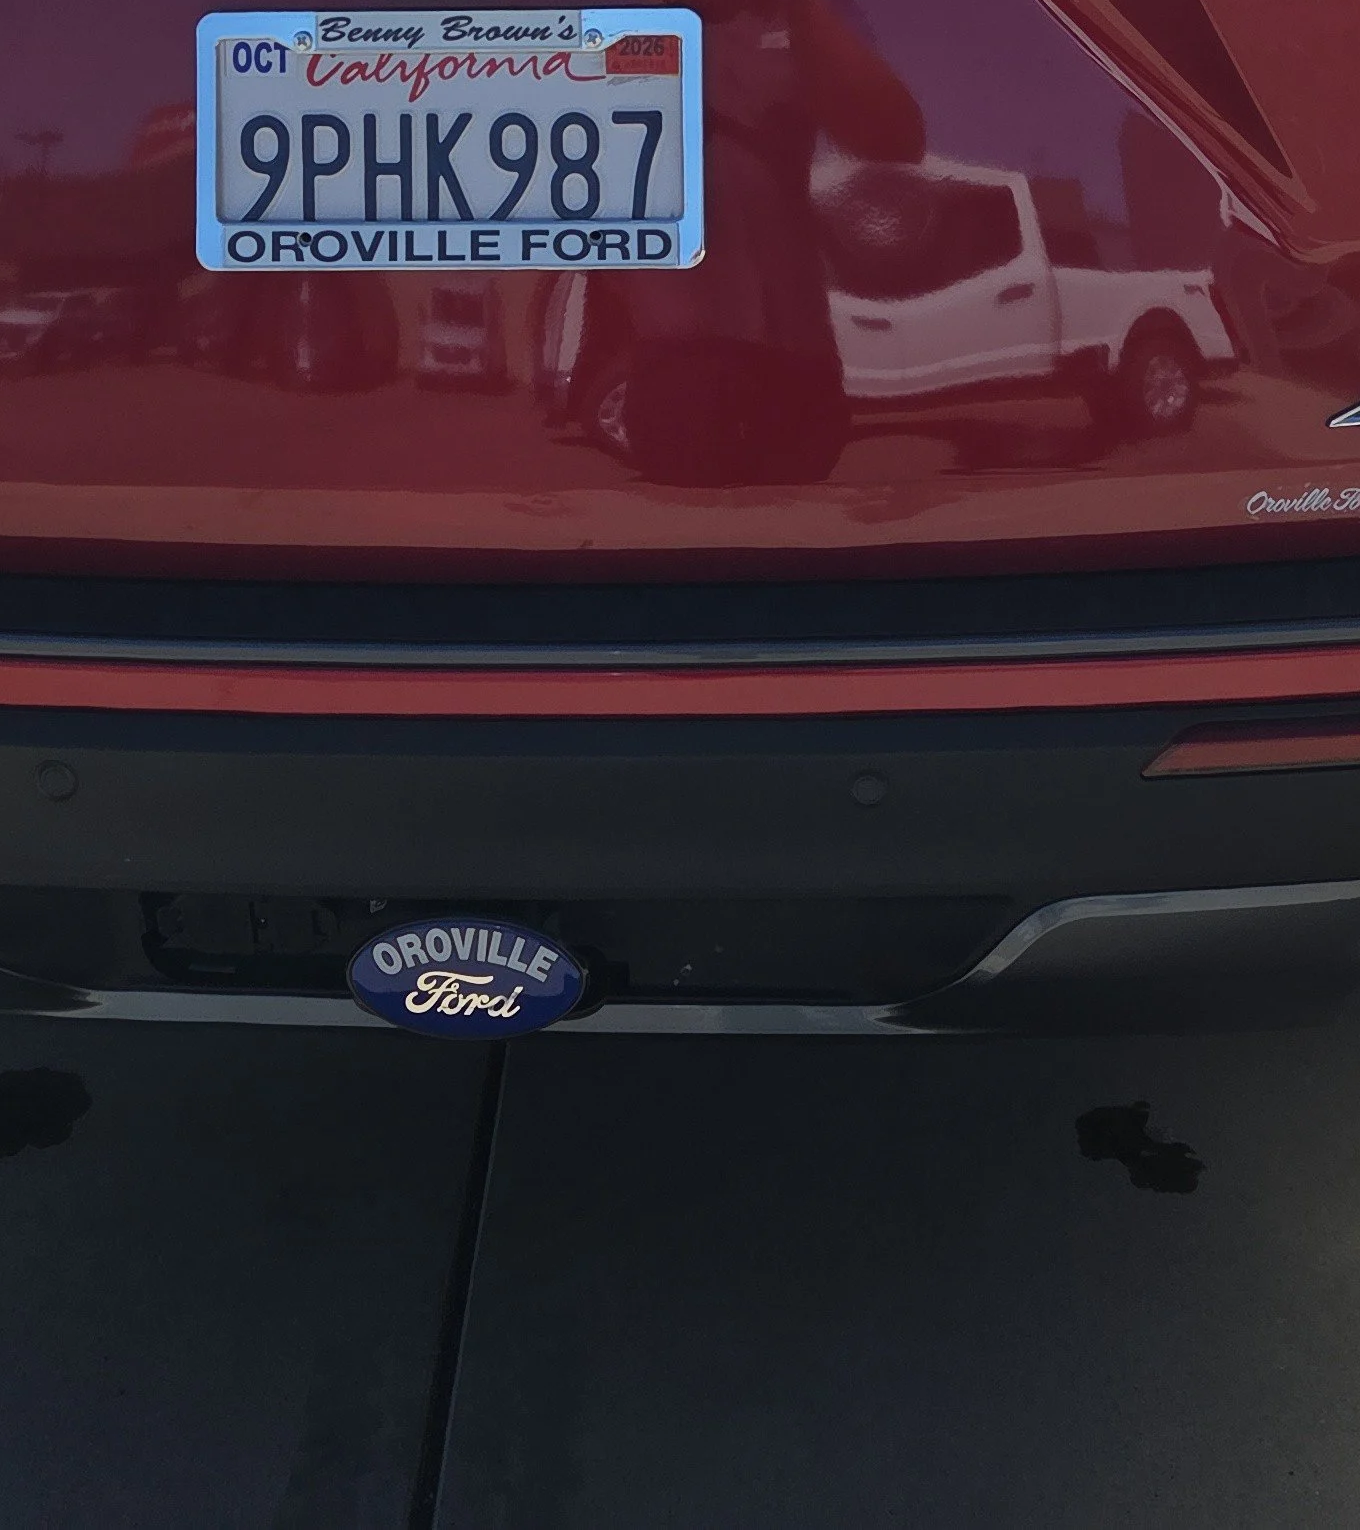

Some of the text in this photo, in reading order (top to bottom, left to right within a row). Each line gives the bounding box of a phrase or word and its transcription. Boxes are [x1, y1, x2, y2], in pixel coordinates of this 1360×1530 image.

[318, 15, 577, 49] Benny Brown's
[619, 36, 665, 57] 2026
[232, 42, 290, 74] OCT
[305, 50, 607, 103] California
[240, 110, 663, 222] 9PHK987
[227, 228, 673, 263] OROVILLE FORD
[372, 926, 559, 983] OROVILLE
[404, 970, 524, 1018] Ford
